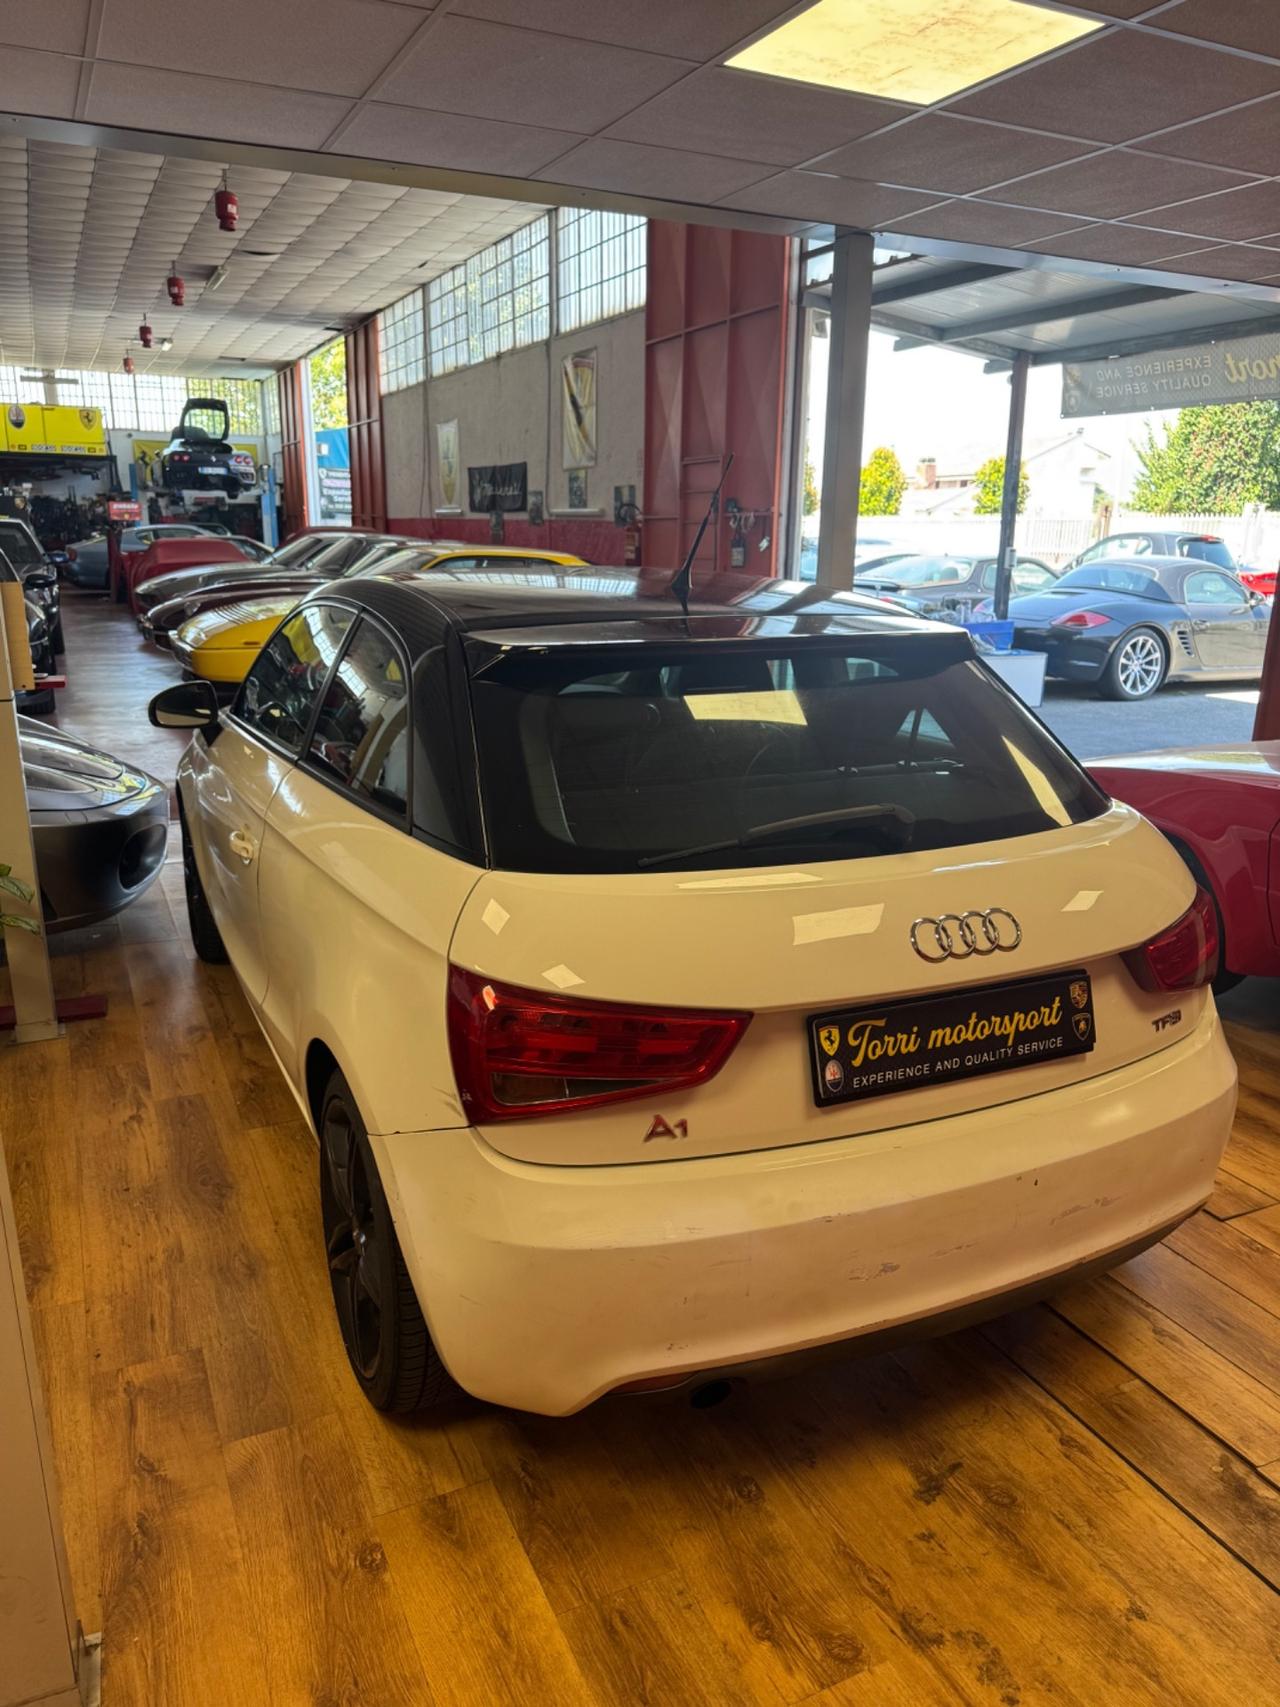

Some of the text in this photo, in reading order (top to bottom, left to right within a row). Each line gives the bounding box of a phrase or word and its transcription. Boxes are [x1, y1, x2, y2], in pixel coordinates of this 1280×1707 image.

[847, 996, 1062, 1068] Torri motorsport
[853, 1036, 1063, 1089] EXPERIENCE AND QUALITY SERVICE
[643, 1113, 688, 1143] A1
